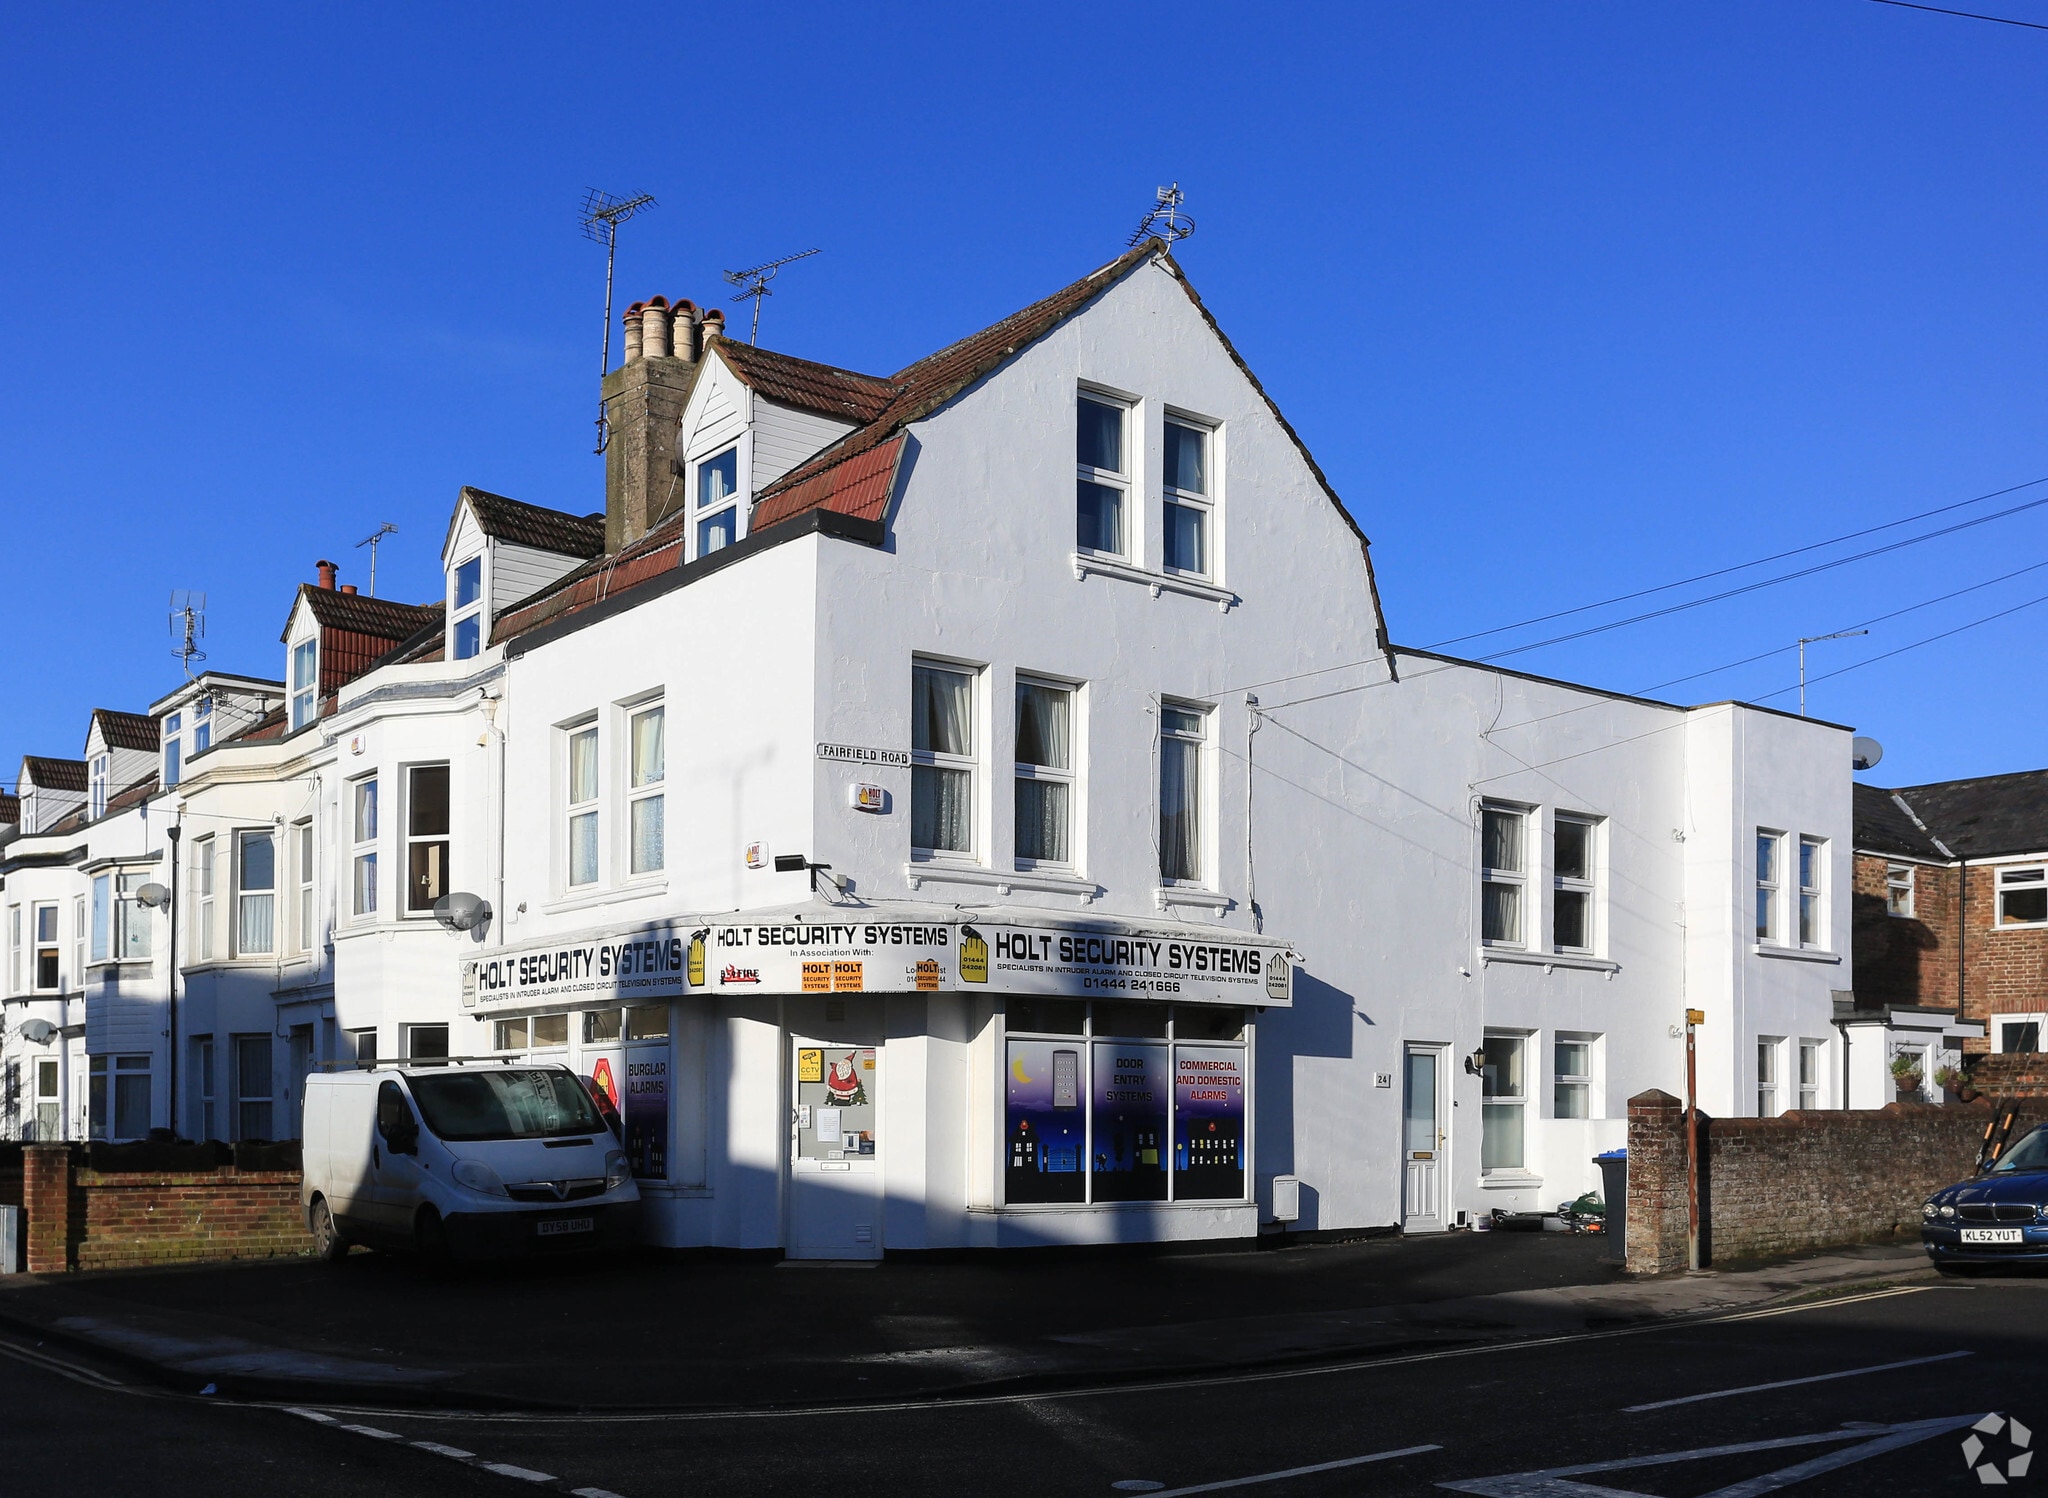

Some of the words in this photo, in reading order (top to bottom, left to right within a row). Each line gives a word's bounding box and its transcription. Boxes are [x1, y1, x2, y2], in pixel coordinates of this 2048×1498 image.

[823, 745, 877, 761] FAIRFIELD
[881, 751, 908, 765] ROAD
[868, 787, 881, 798] HOLT
[717, 927, 752, 947] HOLT
[758, 925, 857, 946] SECURITY
[864, 925, 948, 946] SYSTEMS
[790, 949, 798, 957] In
[800, 948, 851, 957] Association
[852, 948, 874, 956] With:
[995, 932, 1052, 961] HOLT
[1059, 936, 1162, 967] SECURITY
[1169, 943, 1261, 975] SYSTEMS
[479, 959, 515, 991] HOLT
[520, 948, 594, 986] SECURITY
[600, 938, 682, 977] SYSTEMS
[802, 964, 830, 974] HOLT
[835, 963, 863, 973] HOLT
[916, 963, 938, 973] HOLT
[996, 963, 1044, 972] SPECIALISTS
[1045, 965, 1053, 973] IN
[1055, 966, 1090, 975] INTRUDER
[1091, 968, 1116, 976] ALARM
[1117, 969, 1133, 977] AND
[1135, 970, 1162, 978] CLOSED
[1163, 972, 1189, 980] CIRCUIT
[1190, 974, 1227, 983] TELEVISION
[1227, 977, 1259, 985] SYSTEMS
[479, 992, 509, 1003] SPECIALISTS
[510, 991, 516, 999] IN
[516, 989, 541, 998] INTRUDER
[541, 986, 559, 996] ALARM
[560, 985, 572, 993] AND
[572, 983, 595, 991] CLOSED
[597, 981, 617, 990] CIRCUIT
[619, 978, 652, 989] TELEVISION
[652, 976, 682, 986] SYSTEMS
[1083, 978, 1127, 990] 01444
[1131, 979, 1181, 993] 241666
[1116, 1058, 1144, 1069] DOOR
[1179, 1060, 1238, 1071] COMMERCIAL
[628, 1062, 667, 1077] BURGLAR
[800, 1066, 820, 1074] CCTV
[1113, 1074, 1146, 1085] ENTRY
[1175, 1075, 1195, 1085] AND
[1197, 1075, 1241, 1086] DOMESTIC
[1378, 1075, 1387, 1084] 24
[630, 1080, 665, 1095] ALARMS
[1106, 1090, 1153, 1102] SYSTEMS
[1190, 1090, 1227, 1100] ALARMS
[571, 1218, 590, 1231] UHU
[1965, 1230, 1993, 1241] KL52
[1994, 1230, 2017, 1241] YUT
